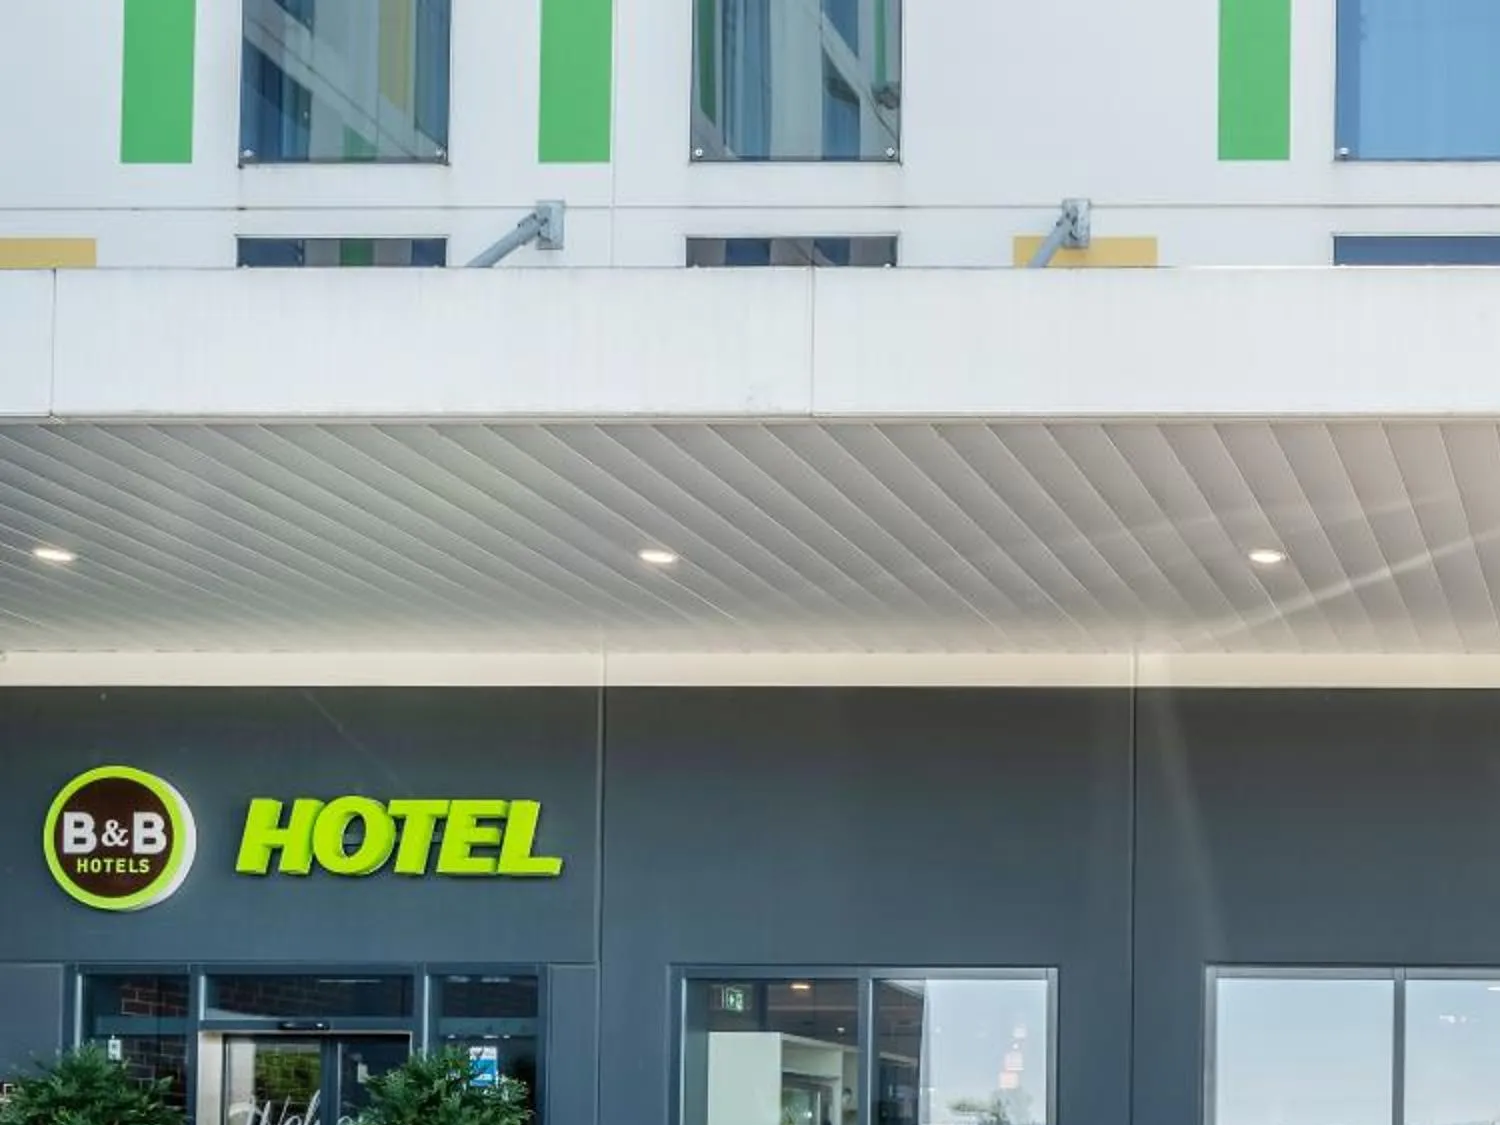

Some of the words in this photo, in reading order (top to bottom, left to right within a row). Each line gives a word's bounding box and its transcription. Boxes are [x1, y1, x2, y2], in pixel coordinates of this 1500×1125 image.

[63, 811, 167, 854] B&B
[235, 796, 562, 876] HOTEL
[76, 858, 150, 873] HOTELS
